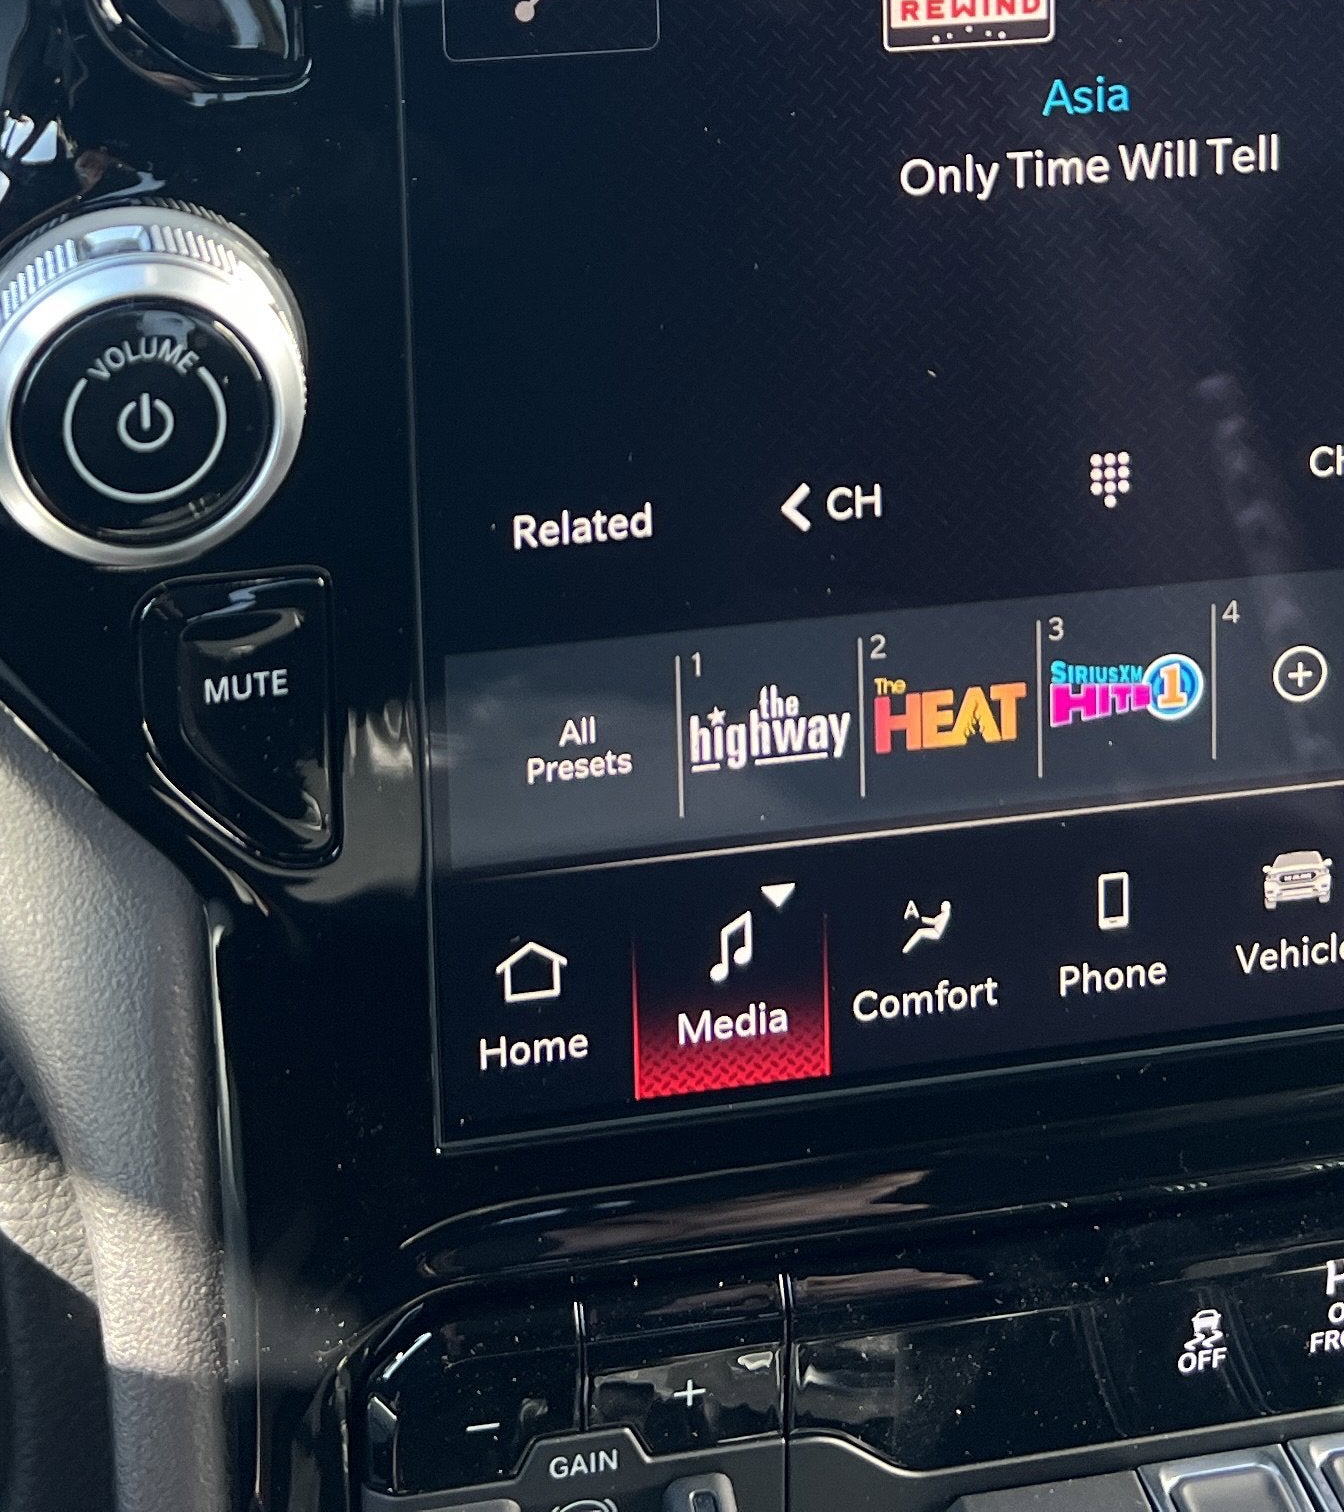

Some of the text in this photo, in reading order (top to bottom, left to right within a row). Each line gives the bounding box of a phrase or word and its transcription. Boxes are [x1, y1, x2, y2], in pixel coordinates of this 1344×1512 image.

[1042, 75, 1131, 117] Asia
[899, 133, 1280, 201] Only Time Will Tell
[85, 337, 202, 382] VOLUME
[826, 483, 883, 521] CH
[512, 501, 654, 550] Related
[1048, 616, 1065, 642] 3
[1221, 599, 1241, 624] 4
[691, 652, 703, 677] 1
[869, 634, 888, 660] 2
[203, 668, 290, 705] MUTE
[758, 684, 800, 718] the
[873, 676, 907, 695] The
[1050, 662, 1188, 728] HITS 1
[558, 715, 597, 748] All
[874, 681, 1027, 754] HEAT
[689, 706, 851, 773] highway
[526, 748, 633, 785] Presets
[1058, 958, 1168, 997] Phone
[853, 975, 999, 1024] Comfort
[677, 1001, 789, 1046] Media
[478, 1032, 589, 1071] Home
[1177, 1346, 1227, 1374] OFF
[549, 1448, 620, 1480] GAIN
